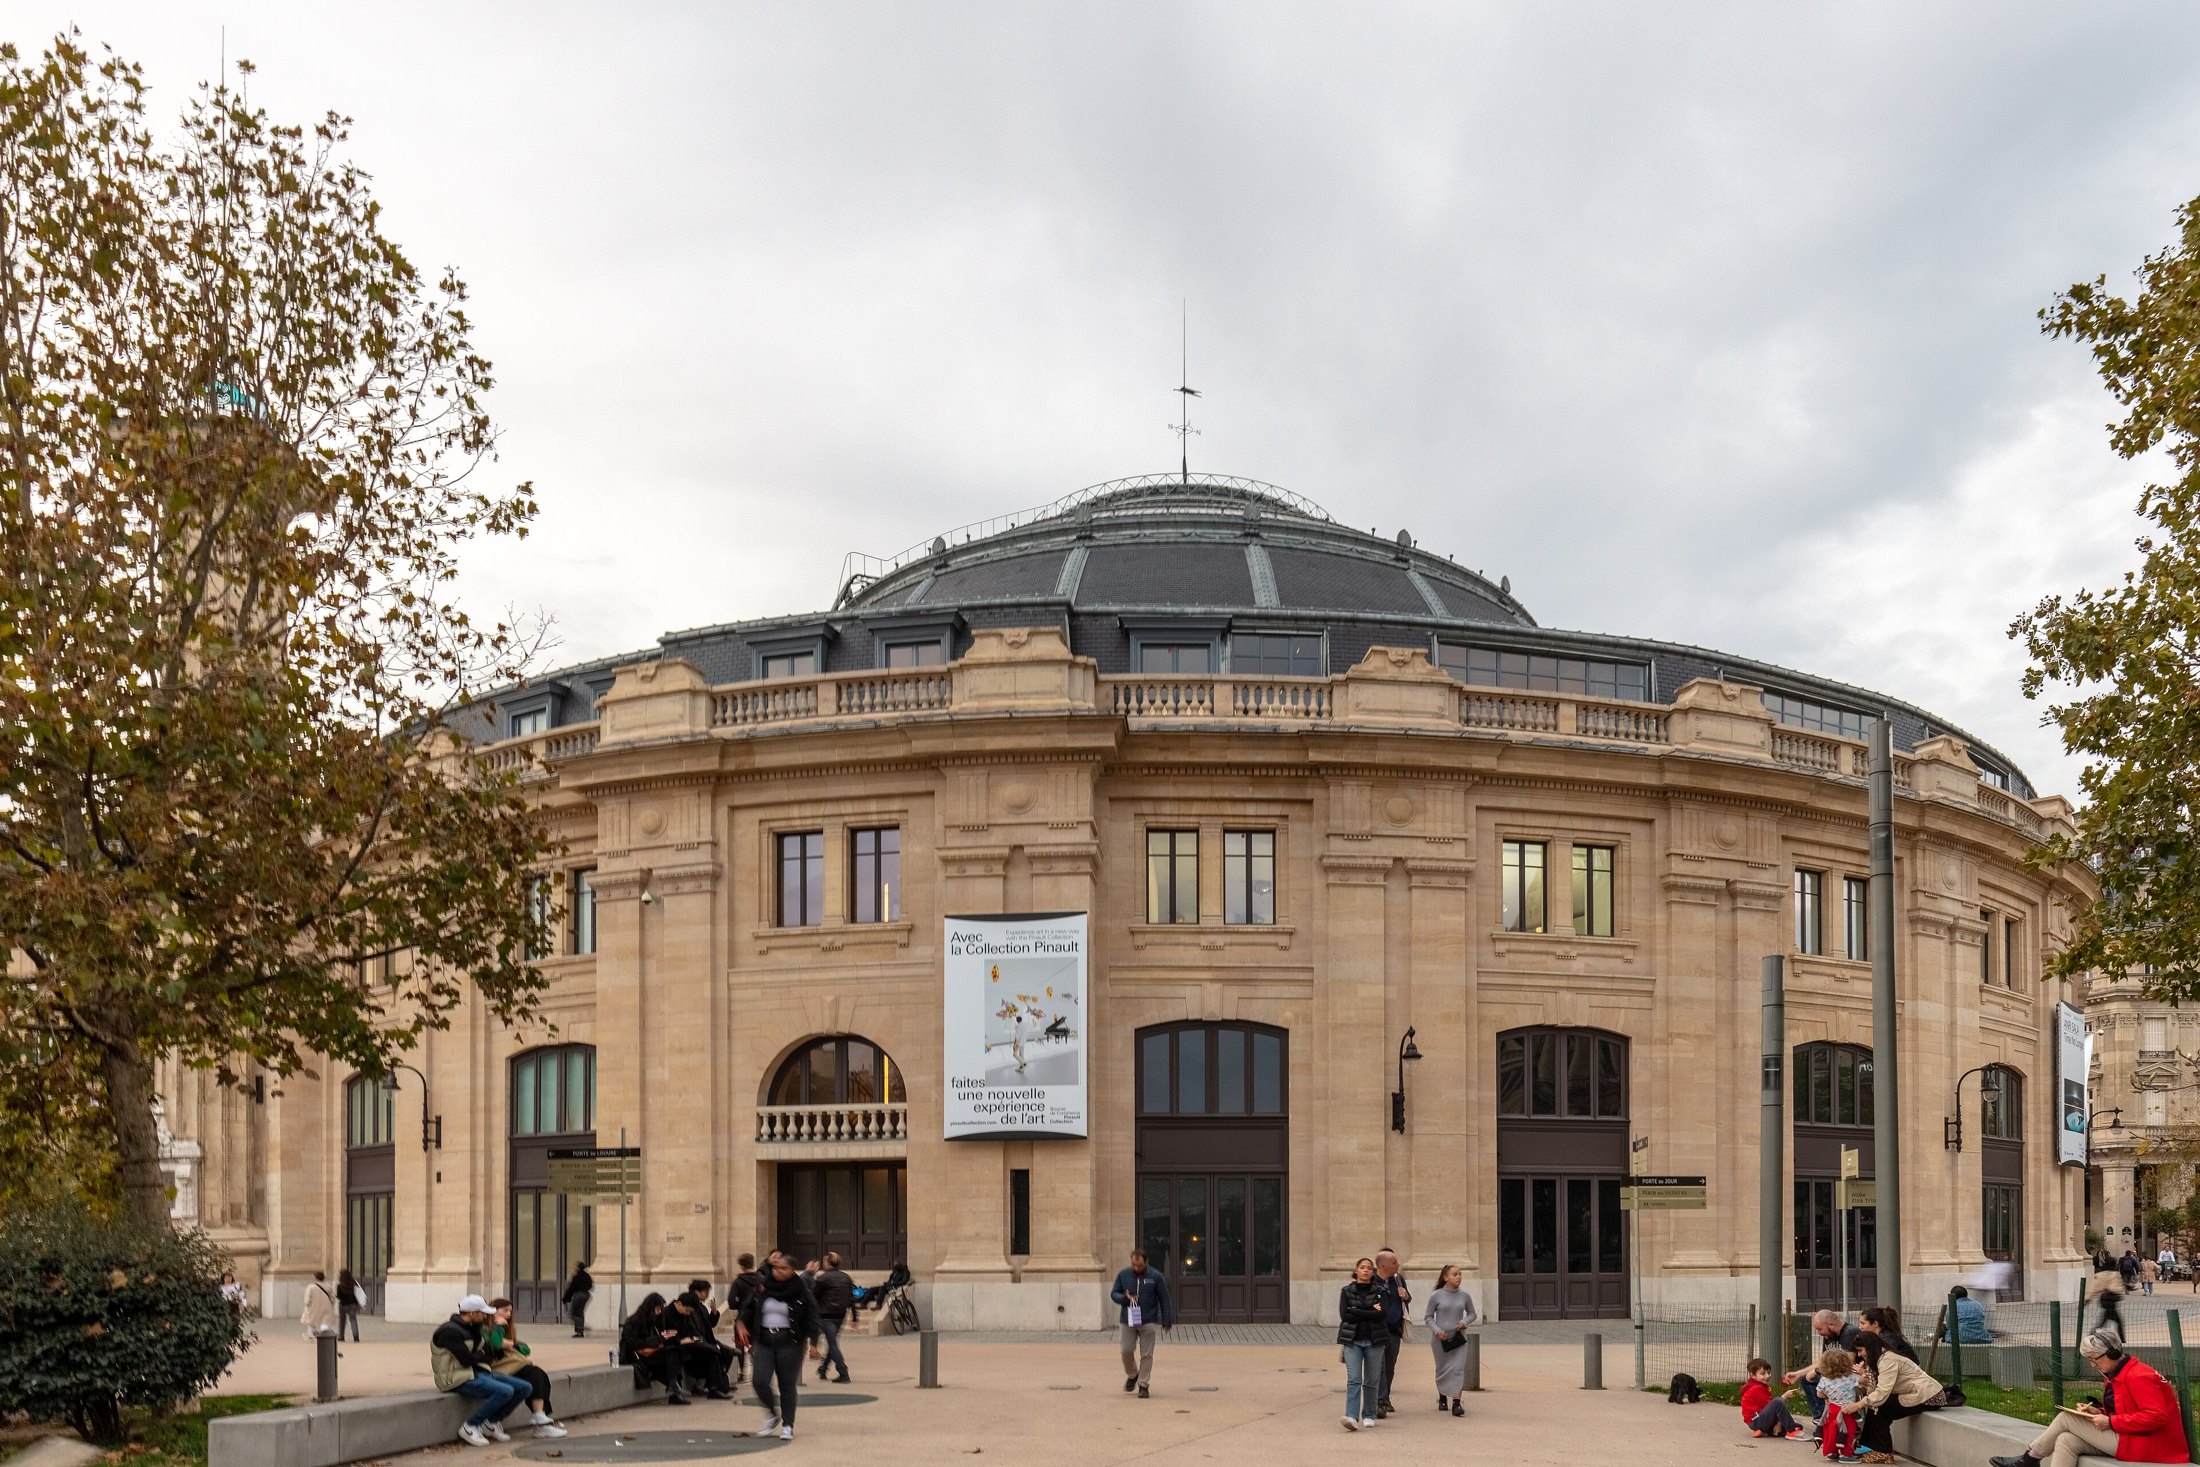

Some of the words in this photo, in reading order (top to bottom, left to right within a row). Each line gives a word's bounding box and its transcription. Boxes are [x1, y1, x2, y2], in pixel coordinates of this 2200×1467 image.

[951, 931, 983, 943] Avec
[951, 943, 962, 956] la
[965, 942, 1030, 956] Collection
[1034, 940, 1080, 953] Pinault
[951, 1077, 986, 1089] faites
[958, 1091, 983, 1101] une
[988, 1088, 1045, 1100] nouvelle
[973, 1101, 1045, 1115] expérience
[1000, 1113, 1017, 1125] de
[1021, 1113, 1045, 1125] l'art
